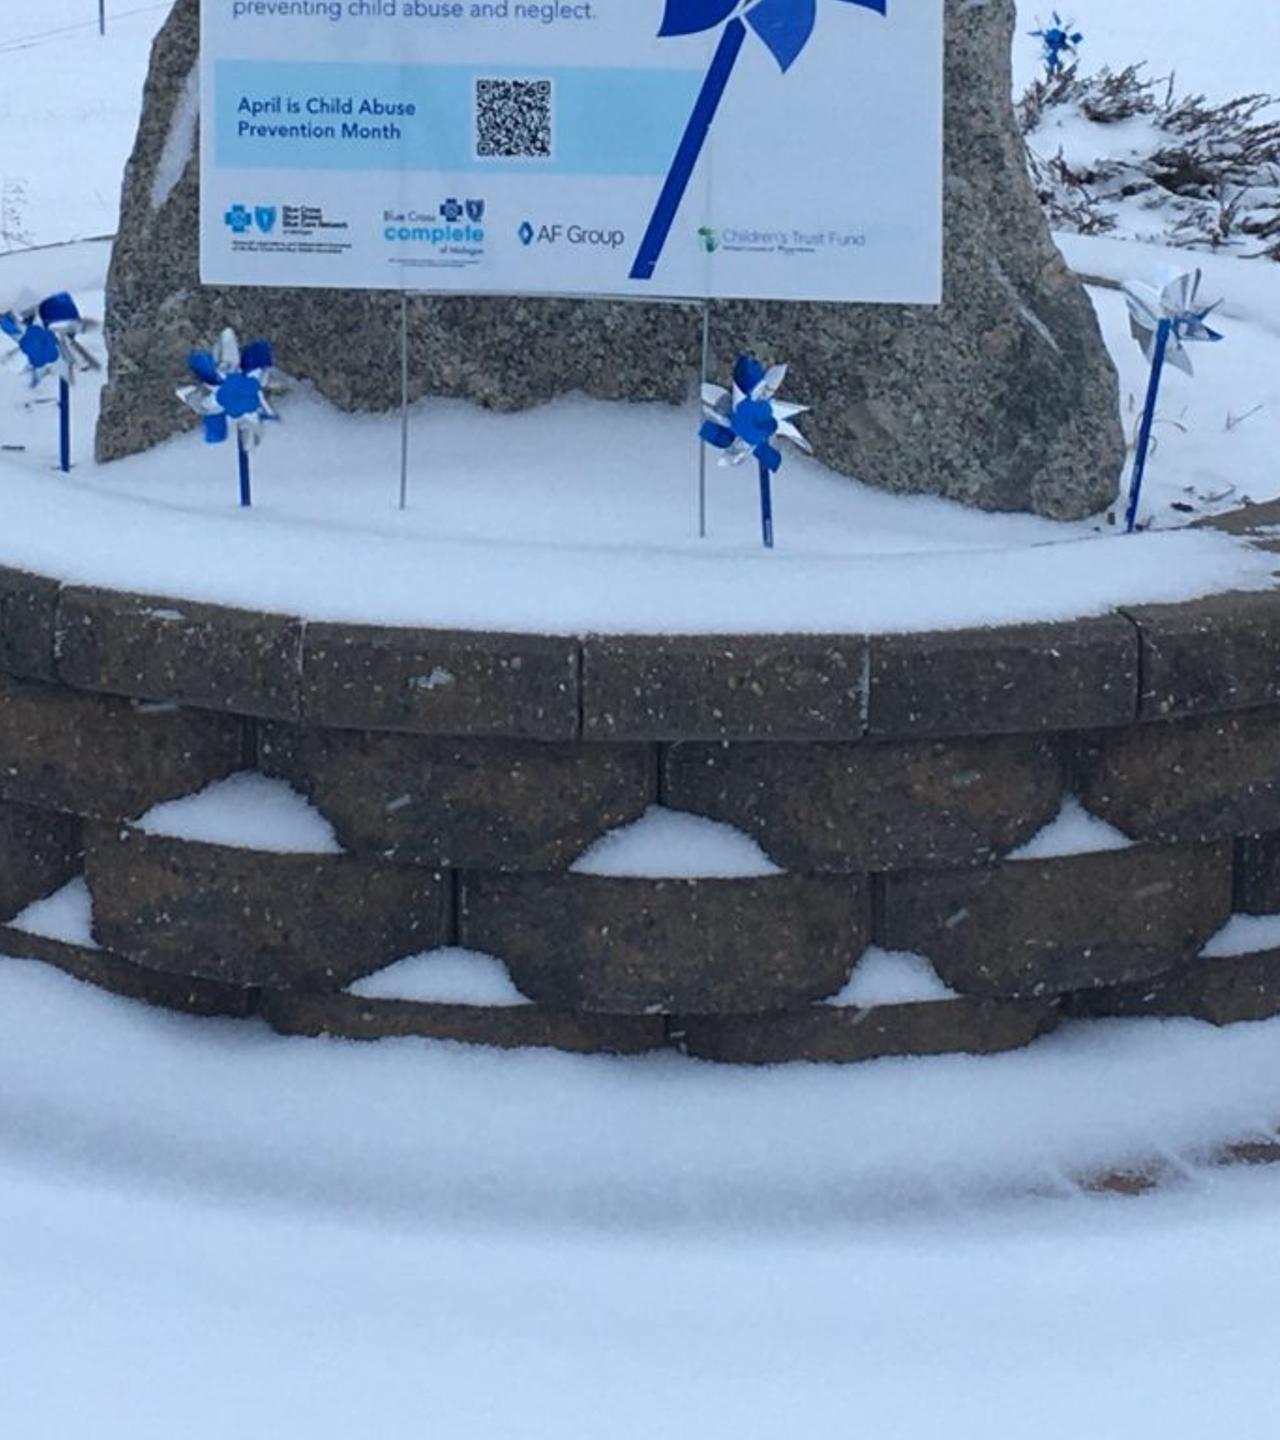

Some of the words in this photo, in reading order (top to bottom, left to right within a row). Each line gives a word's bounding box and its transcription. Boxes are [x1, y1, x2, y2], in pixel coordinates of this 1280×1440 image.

[514, 0, 598, 24] neglect.
[237, 96, 282, 119] April
[286, 97, 301, 114] is
[305, 97, 353, 115] Child
[358, 97, 417, 116] Abuse
[237, 120, 336, 139] Prevention
[341, 121, 402, 140] Month
[383, 224, 485, 245] complete
[536, 224, 563, 244] AF
[566, 224, 625, 250] Group
[828, 231, 867, 247] Fund
